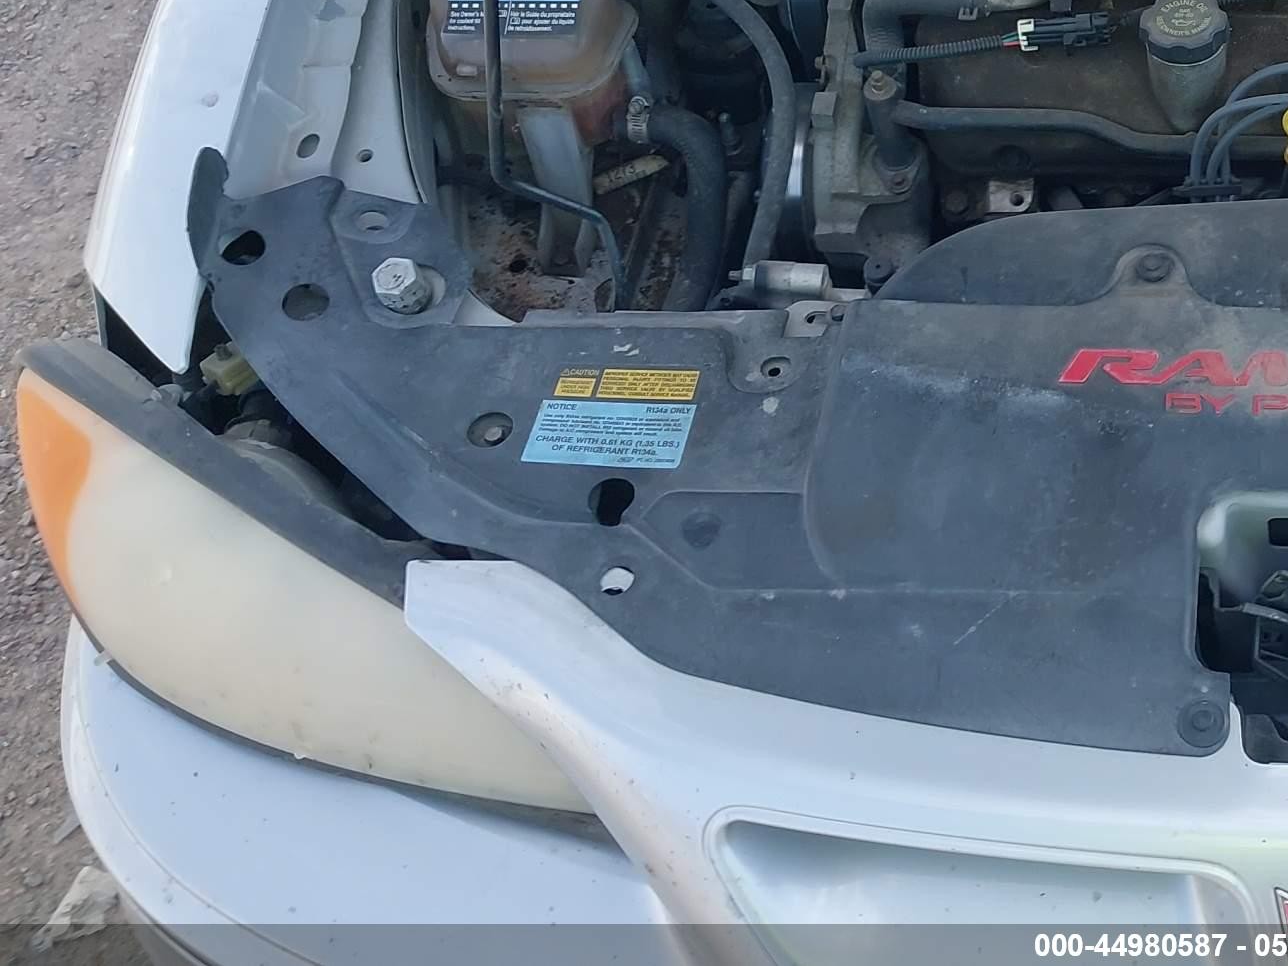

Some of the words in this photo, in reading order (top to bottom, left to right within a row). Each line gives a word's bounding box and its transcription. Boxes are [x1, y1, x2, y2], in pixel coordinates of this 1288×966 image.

[1161, 0, 1196, 13] ENGINE
[570, 368, 599, 376] CAUTION
[547, 403, 577, 411] NOTICE
[646, 406, 668, 414] R134a
[670, 407, 691, 415] ONLY
[1164, 391, 1238, 416] BY
[535, 435, 574, 443] CHARGE
[600, 438, 618, 446] 0.61
[634, 440, 655, 448] (1.35
[657, 440, 680, 449] LBS.)
[566, 445, 631, 454] REFRIGERANT
